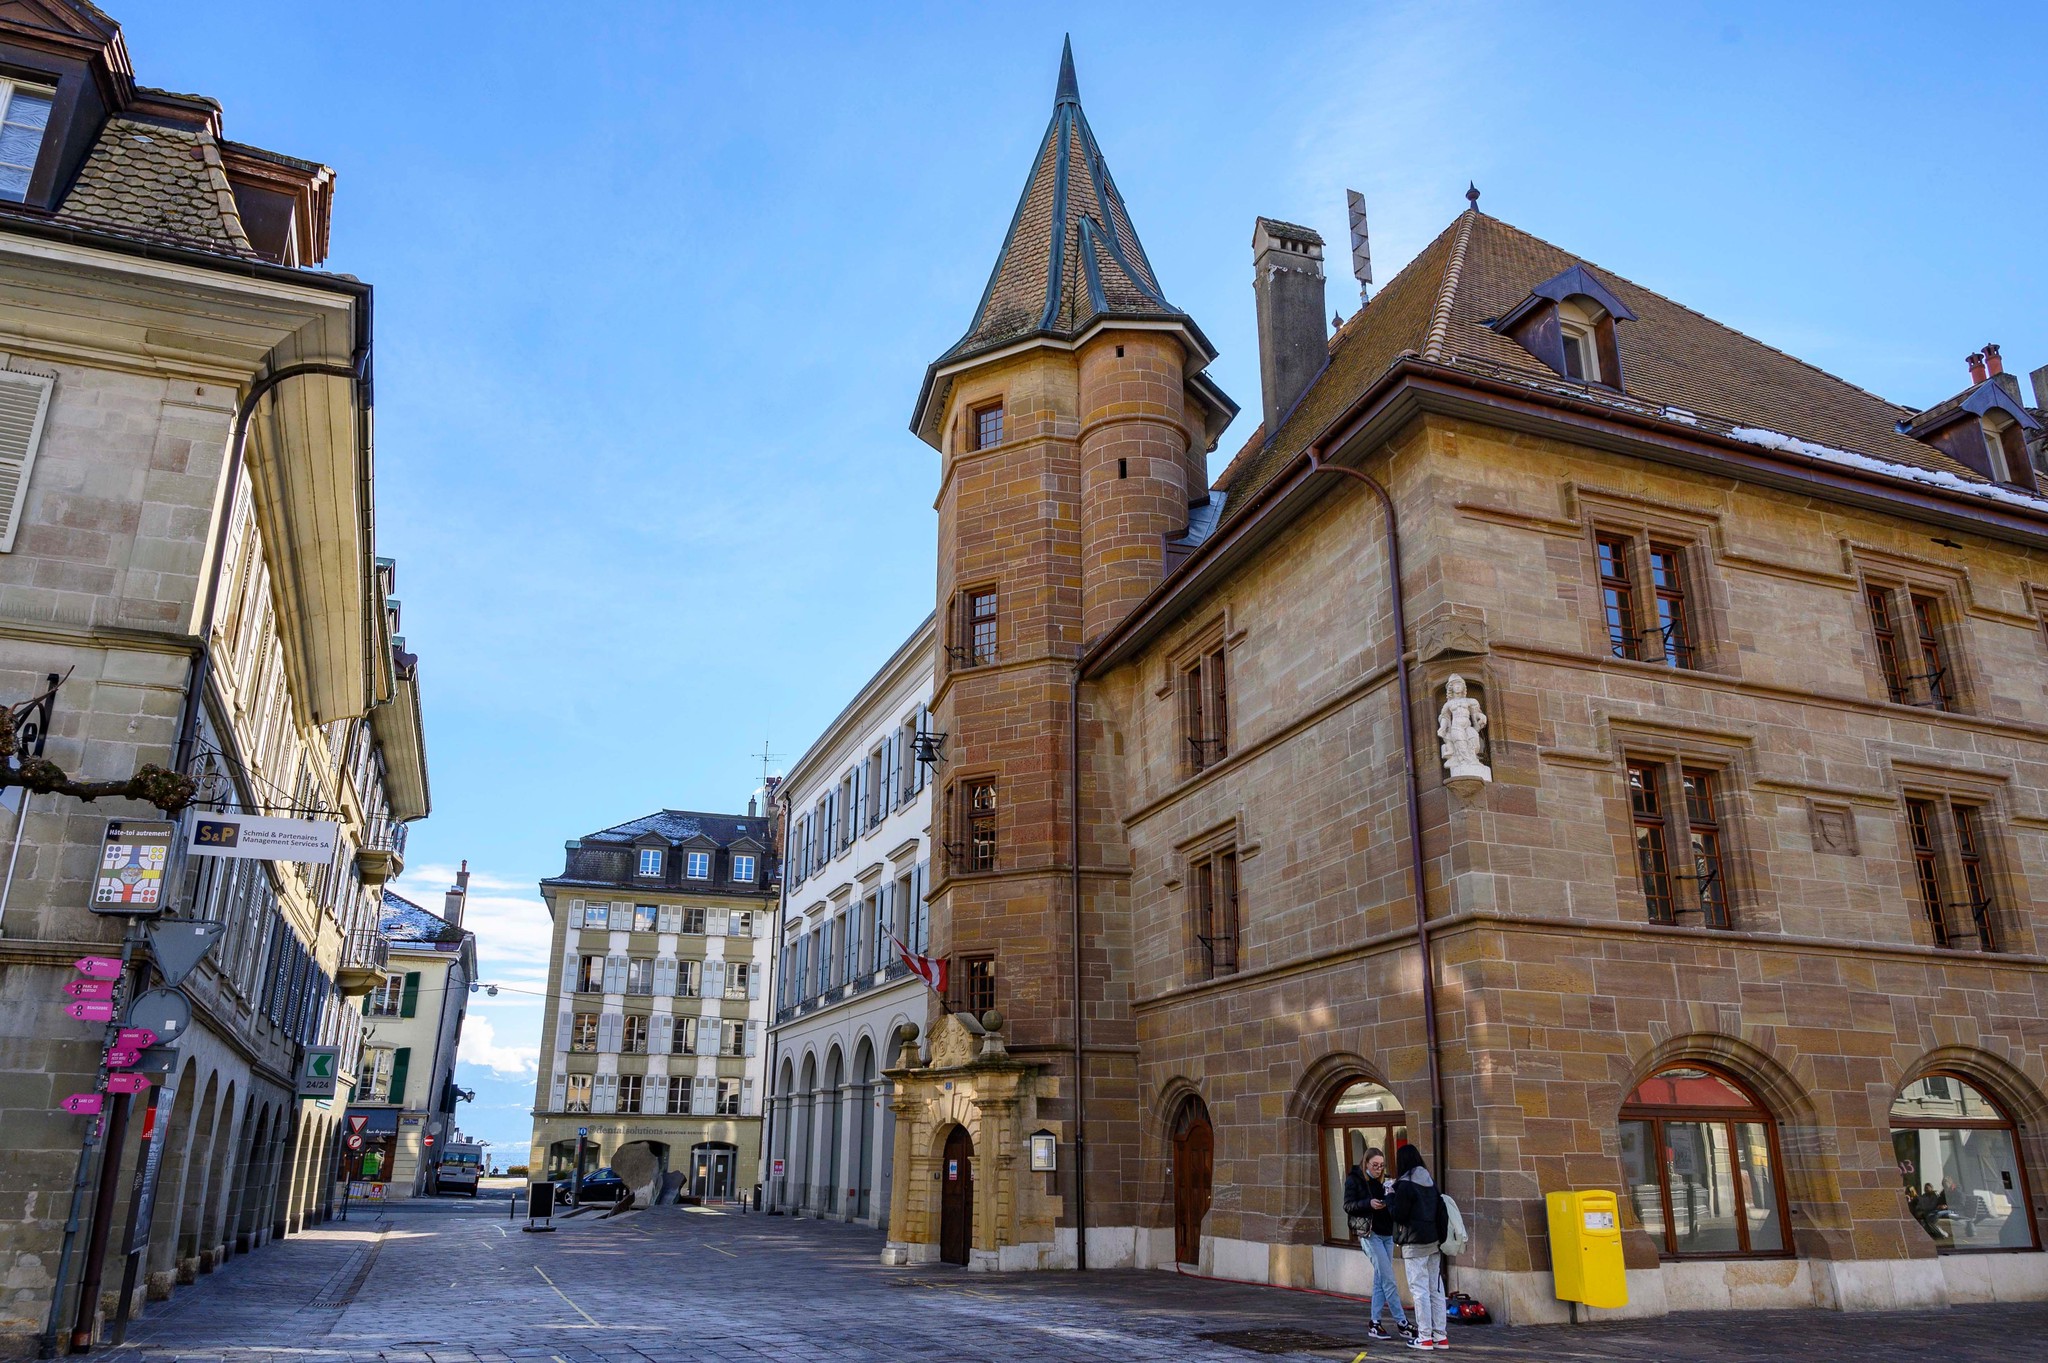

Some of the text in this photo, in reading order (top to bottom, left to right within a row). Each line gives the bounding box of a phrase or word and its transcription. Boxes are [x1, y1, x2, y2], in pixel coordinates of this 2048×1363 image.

[200, 825, 235, 842] S&P
[243, 829, 270, 838] Schmid
[278, 832, 318, 842] Partenaires
[242, 836, 289, 846] Management
[290, 839, 319, 848] Services
[306, 1080, 329, 1088] 24/24
